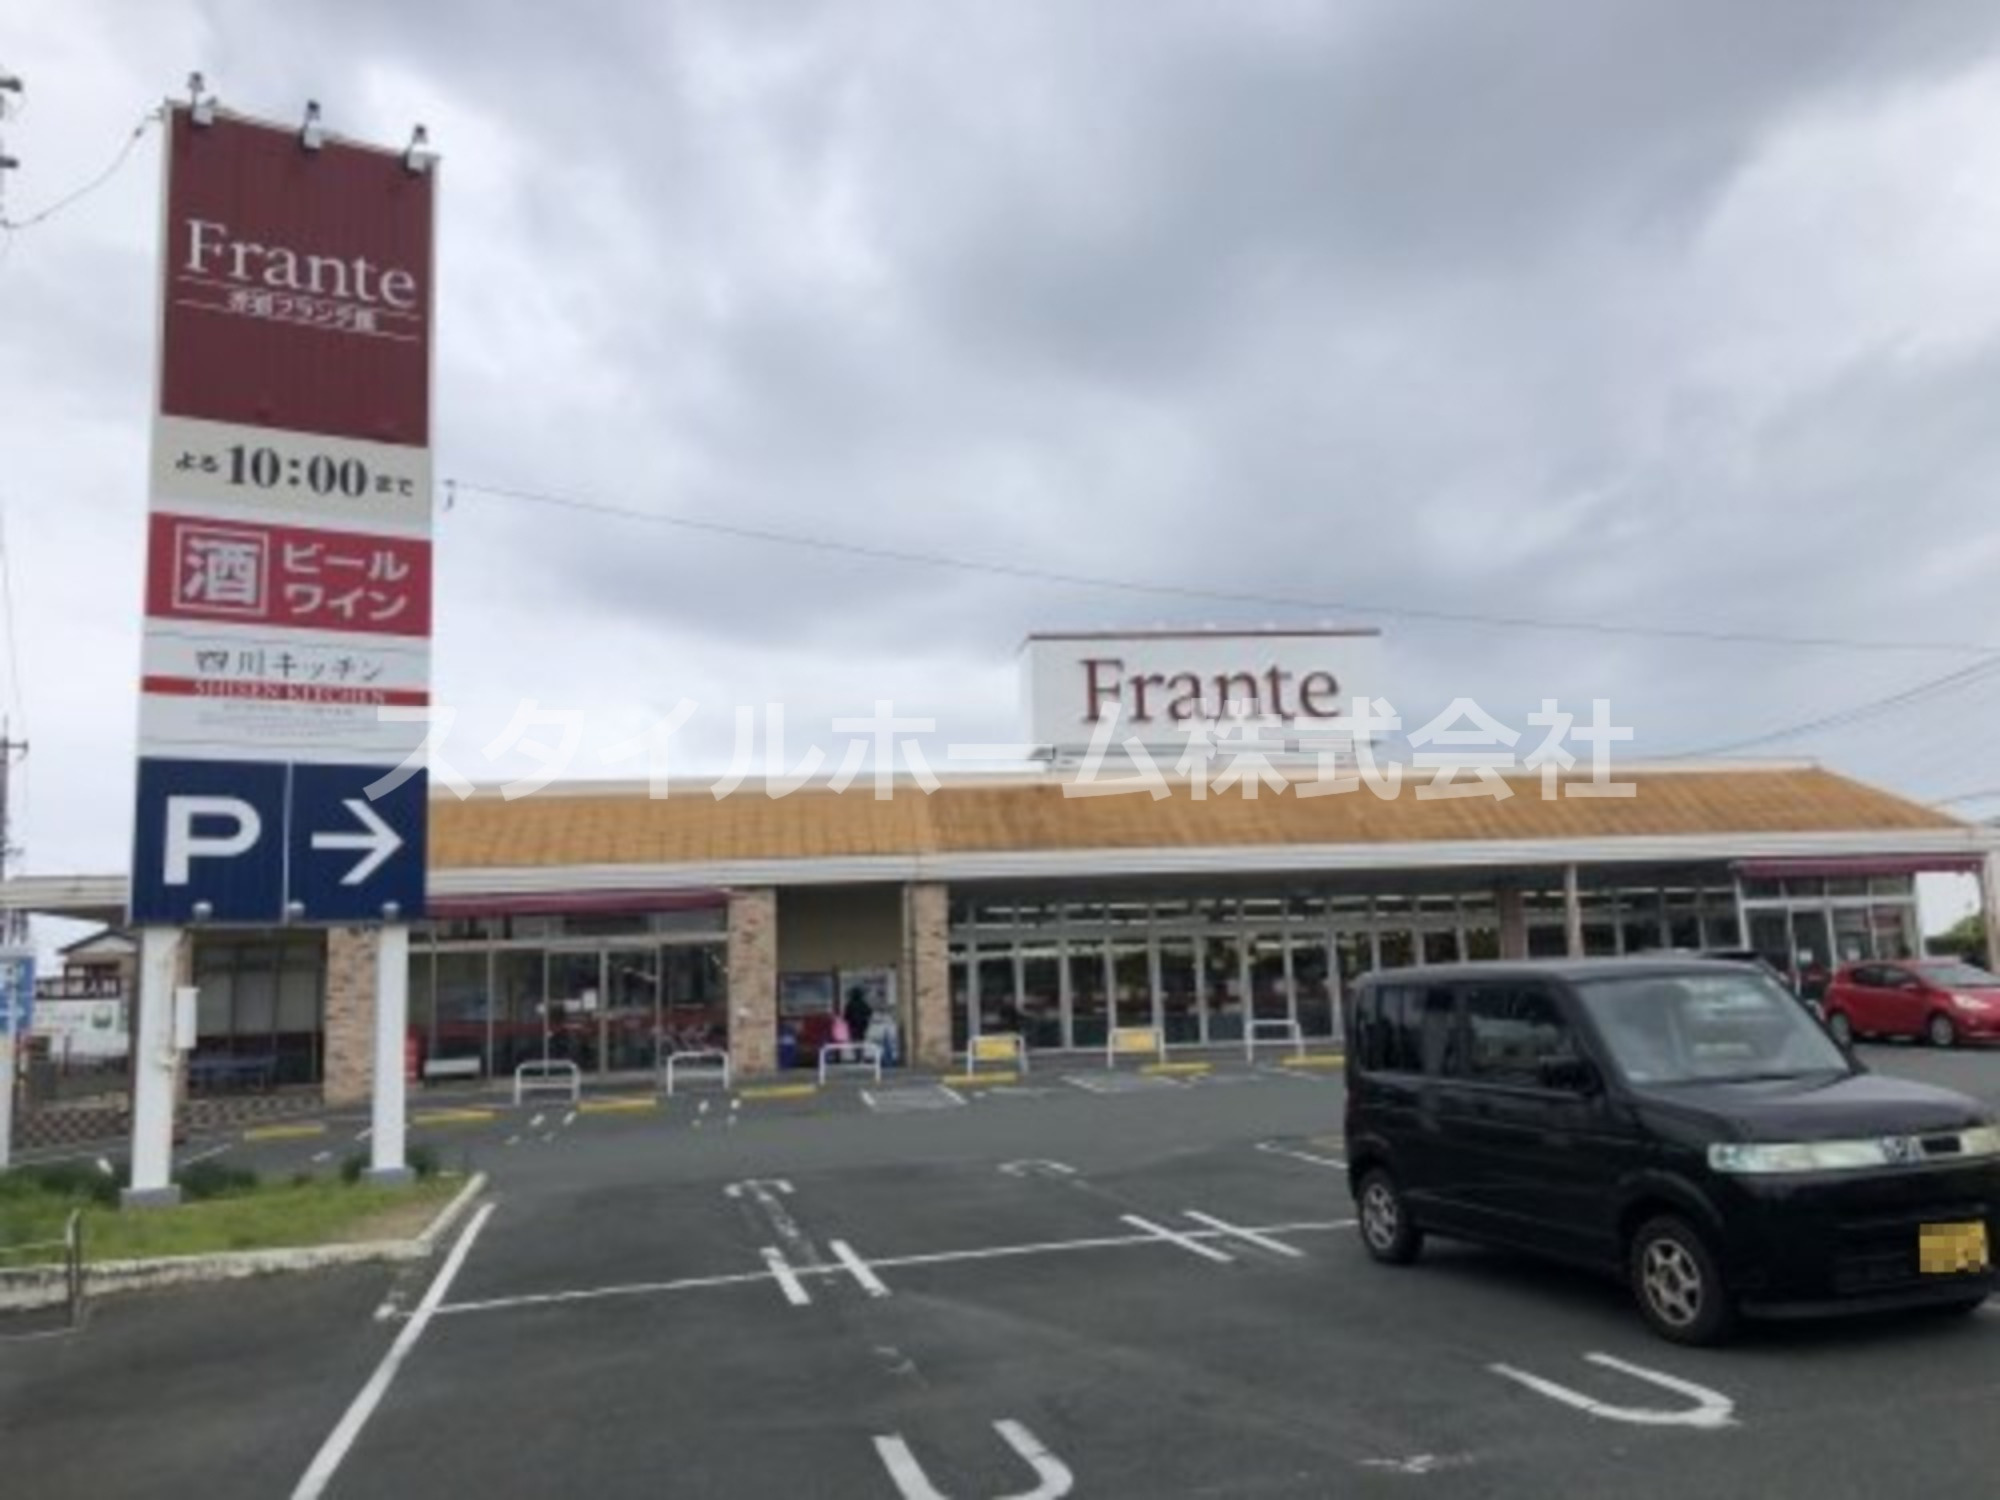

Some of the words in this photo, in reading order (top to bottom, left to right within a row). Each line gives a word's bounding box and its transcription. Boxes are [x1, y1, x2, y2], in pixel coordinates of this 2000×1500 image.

[186, 218, 415, 308] Frante
[184, 537, 262, 606] 酒
[283, 543, 409, 582] ビール
[283, 584, 407, 620] ワイン
[1079, 658, 1343, 725] Frante
[163, 795, 262, 885] P
